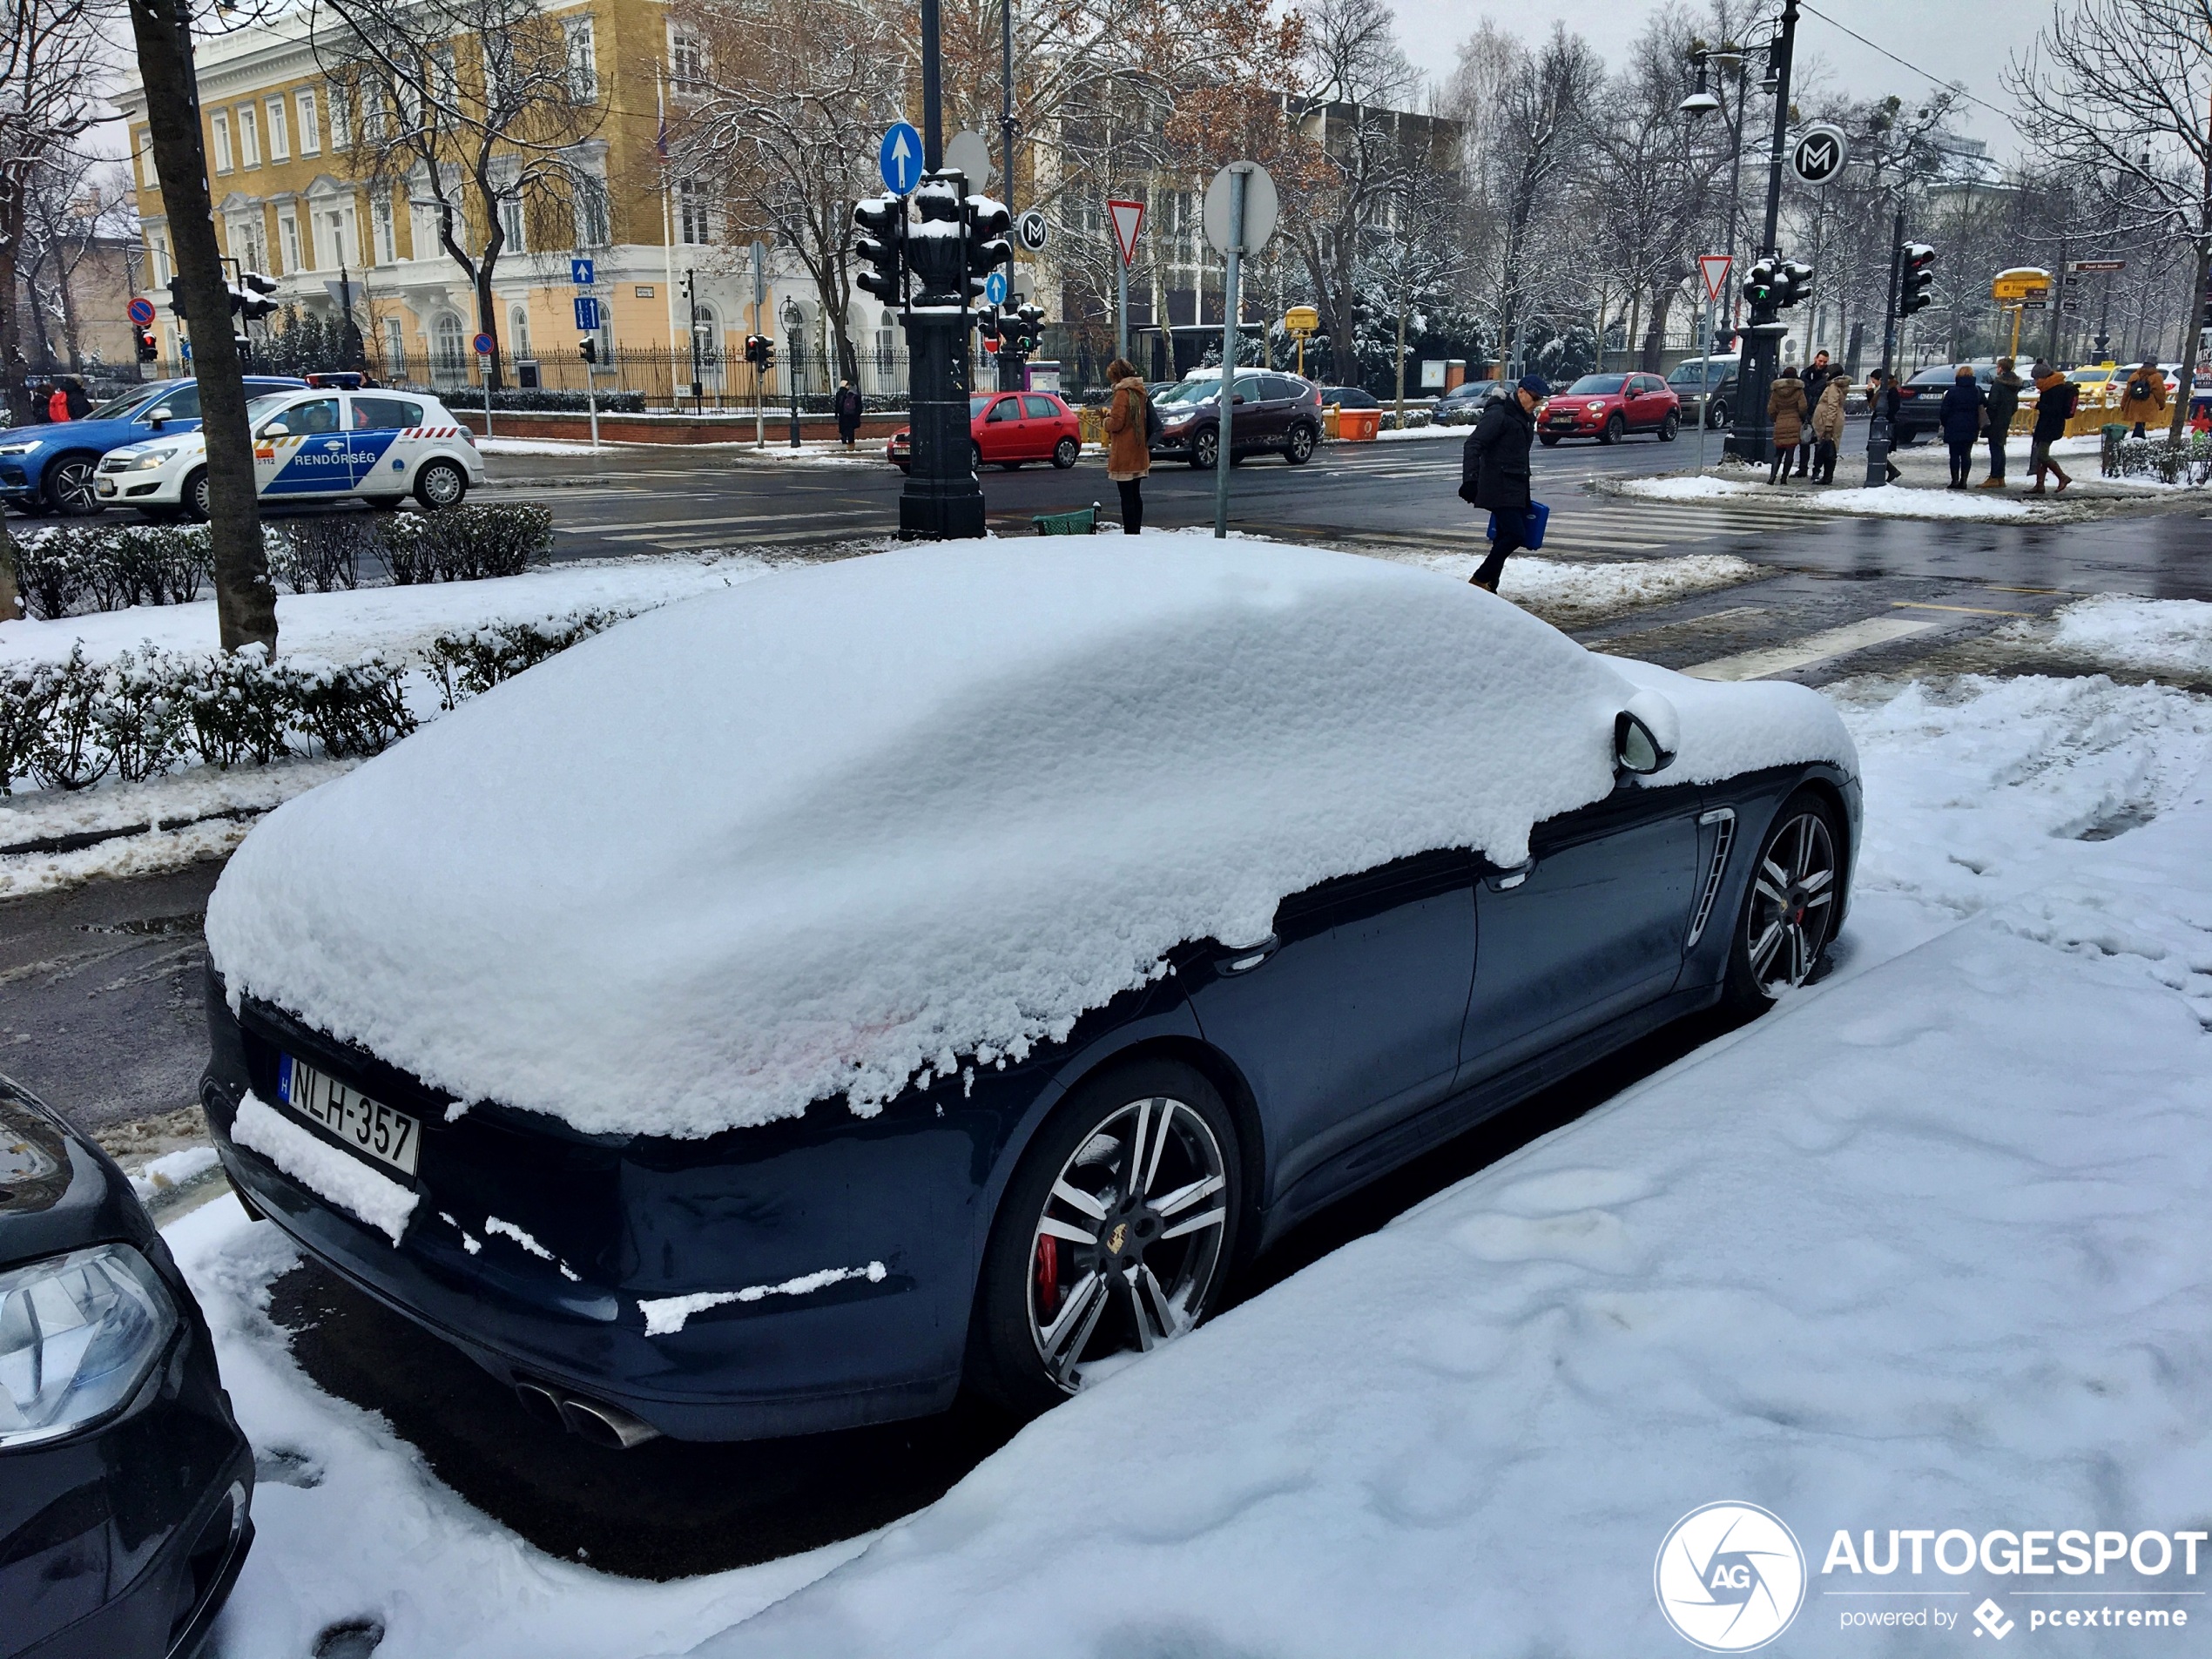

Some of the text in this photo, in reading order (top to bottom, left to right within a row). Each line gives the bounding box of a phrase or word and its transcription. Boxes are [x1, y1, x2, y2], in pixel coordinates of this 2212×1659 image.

[1802, 141, 1831, 172] M
[1028, 219, 1043, 242] M
[294, 450, 376, 466] RENDŐRSÉG
[280, 1076, 288, 1095] H
[293, 1060, 412, 1162] NLH-357
